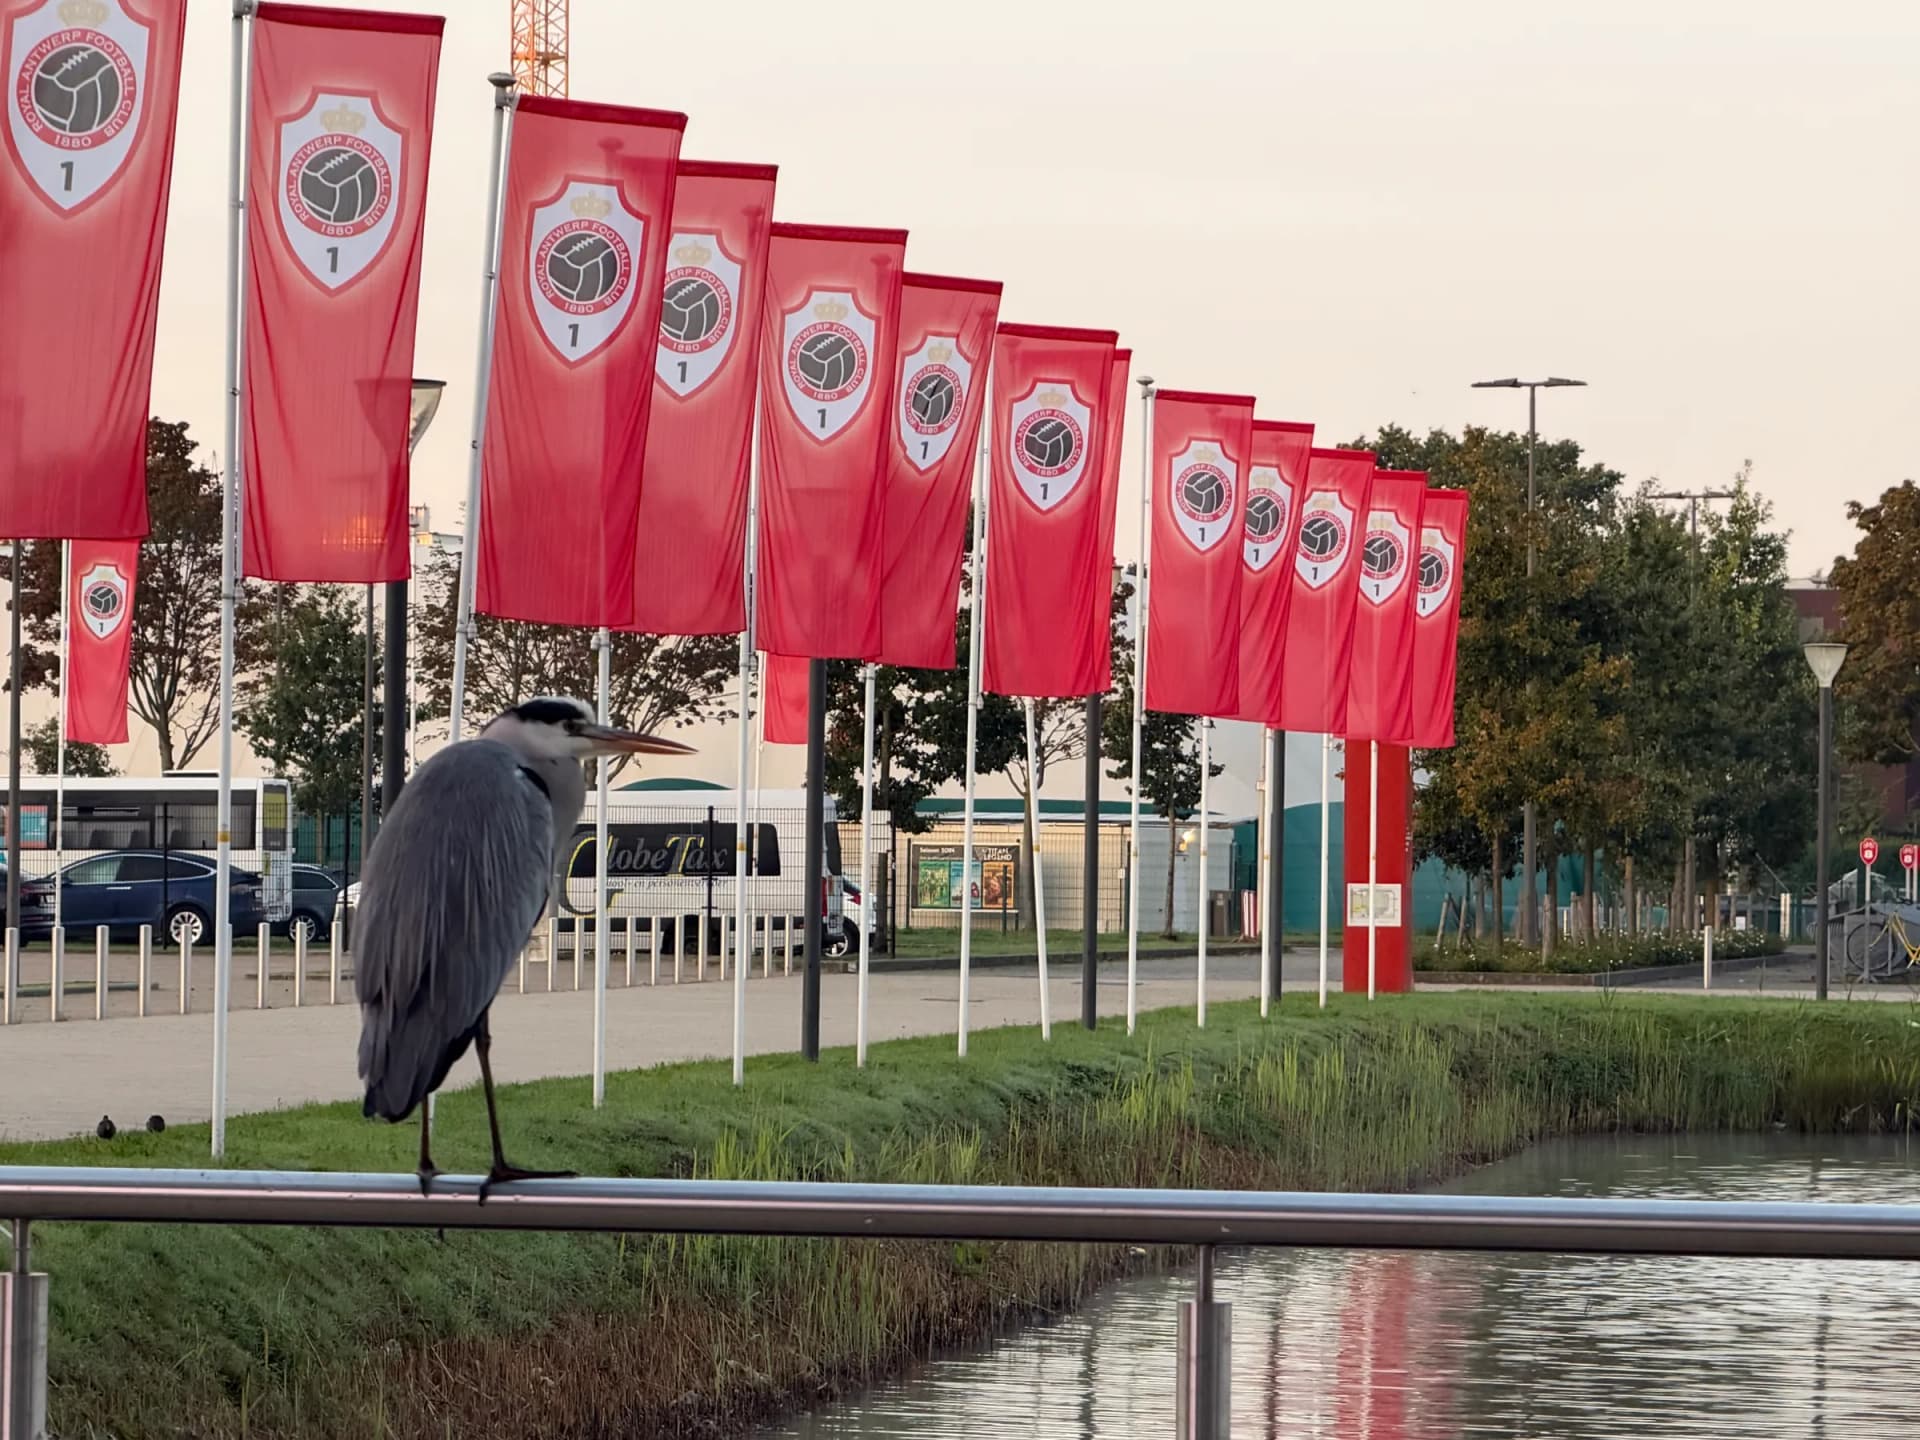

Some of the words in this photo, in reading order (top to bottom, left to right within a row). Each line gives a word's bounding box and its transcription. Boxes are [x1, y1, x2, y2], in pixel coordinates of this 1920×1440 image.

[21, 31, 81, 81] ANTWERP
[86, 32, 134, 97] FOOTBALL
[20, 88, 43, 132] ROYAL
[104, 100, 132, 137] CLUB
[55, 134, 92, 148] 1880
[290, 135, 342, 179] ANTWERP
[346, 137, 389, 192] FOOTBALL
[60, 161, 74, 192] 1
[289, 180, 309, 222] ROYAL
[364, 195, 388, 227] CLUB
[321, 224, 353, 235] 1880
[540, 221, 588, 260] ANTWERP
[326, 247, 339, 273] 1
[592, 222, 630, 273] FOOTBALL
[537, 264, 555, 299] ROYAL
[604, 278, 628, 306] CLUB
[695, 268, 730, 314] FOOTBALL
[564, 302, 594, 313] 1880
[568, 323, 579, 347] 1
[708, 318, 729, 344] CLUB
[672, 343, 700, 352] 1880
[791, 323, 830, 355] ANTWERP
[832, 324, 865, 368] FOOTBALL
[677, 361, 688, 383] 1
[817, 408, 826, 428] 1
[920, 440, 928, 460] 1
[1040, 482, 1048, 500] 1
[1198, 527, 1205, 542] 1
[1253, 548, 1259, 562] 1
[1312, 567, 1318, 580] 1
[1374, 584, 1380, 596] 1
[1420, 598, 1426, 610] 1
[99, 622, 104, 632] 1
